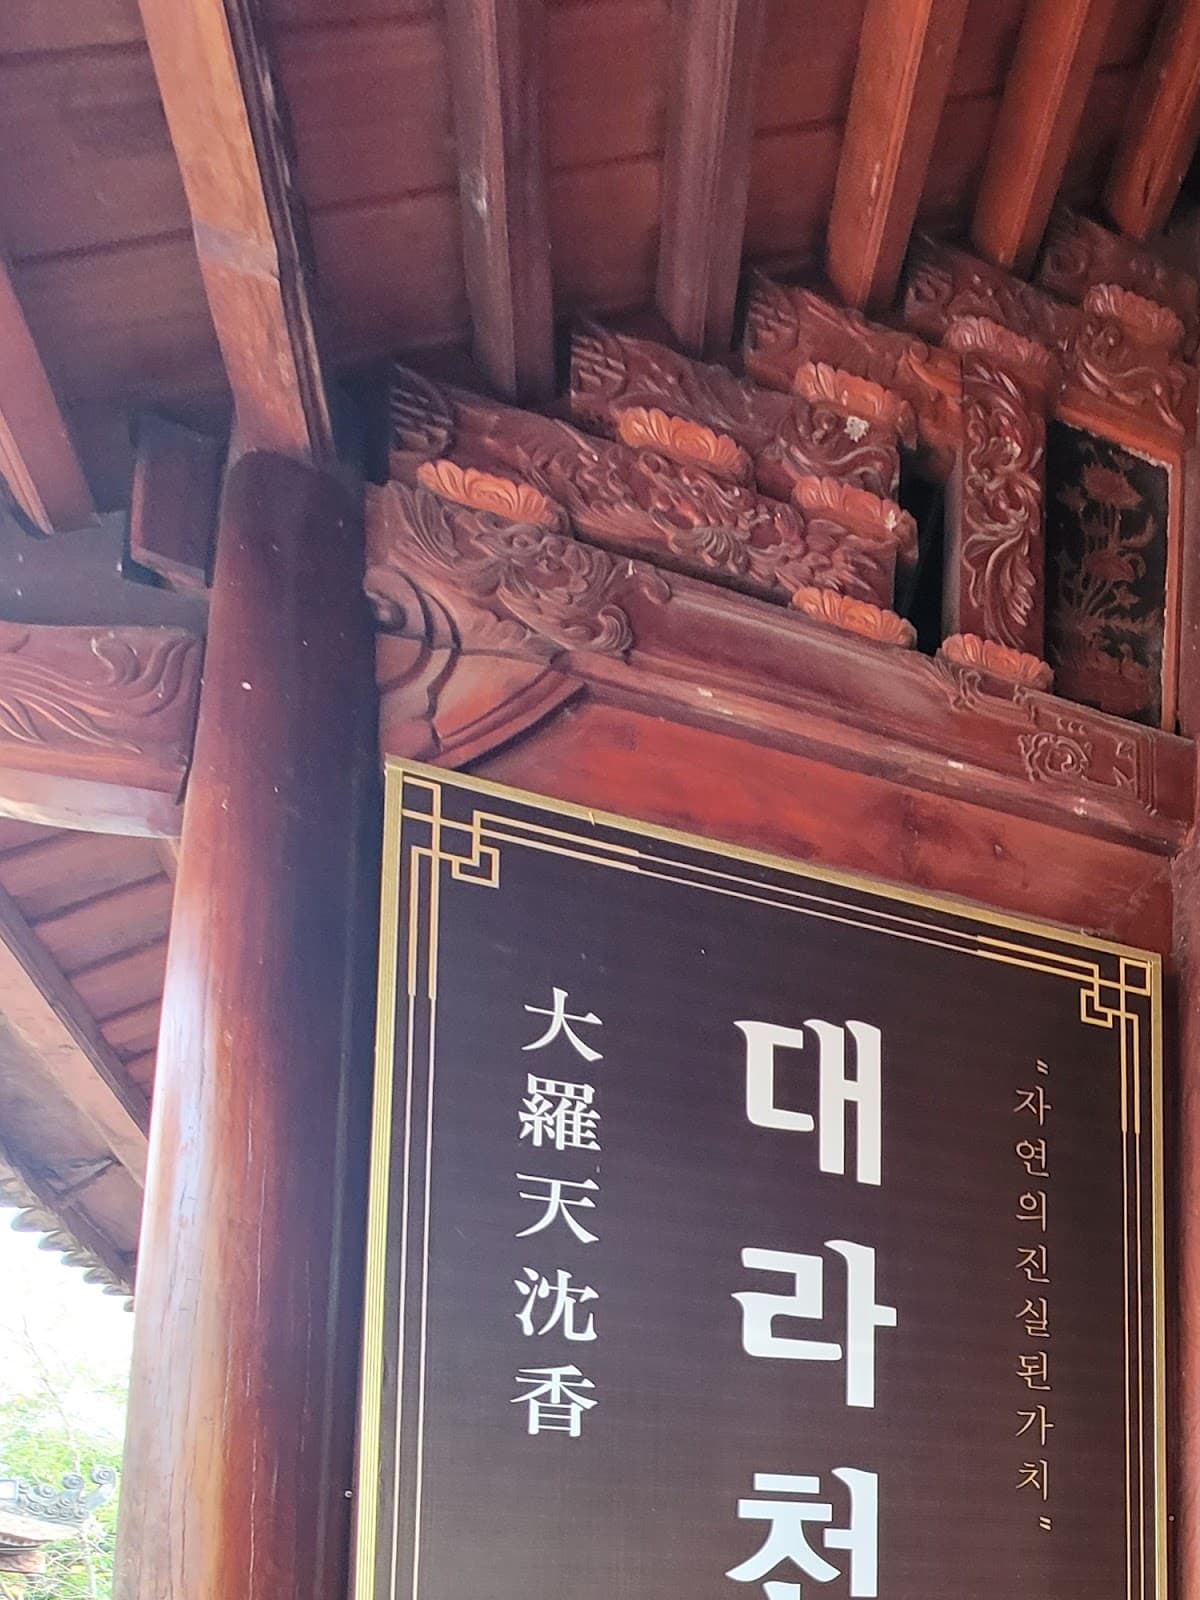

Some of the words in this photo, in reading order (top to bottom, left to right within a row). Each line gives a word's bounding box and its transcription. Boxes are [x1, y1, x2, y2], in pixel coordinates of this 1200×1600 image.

[510, 987, 603, 1438] 大羅天沈香
